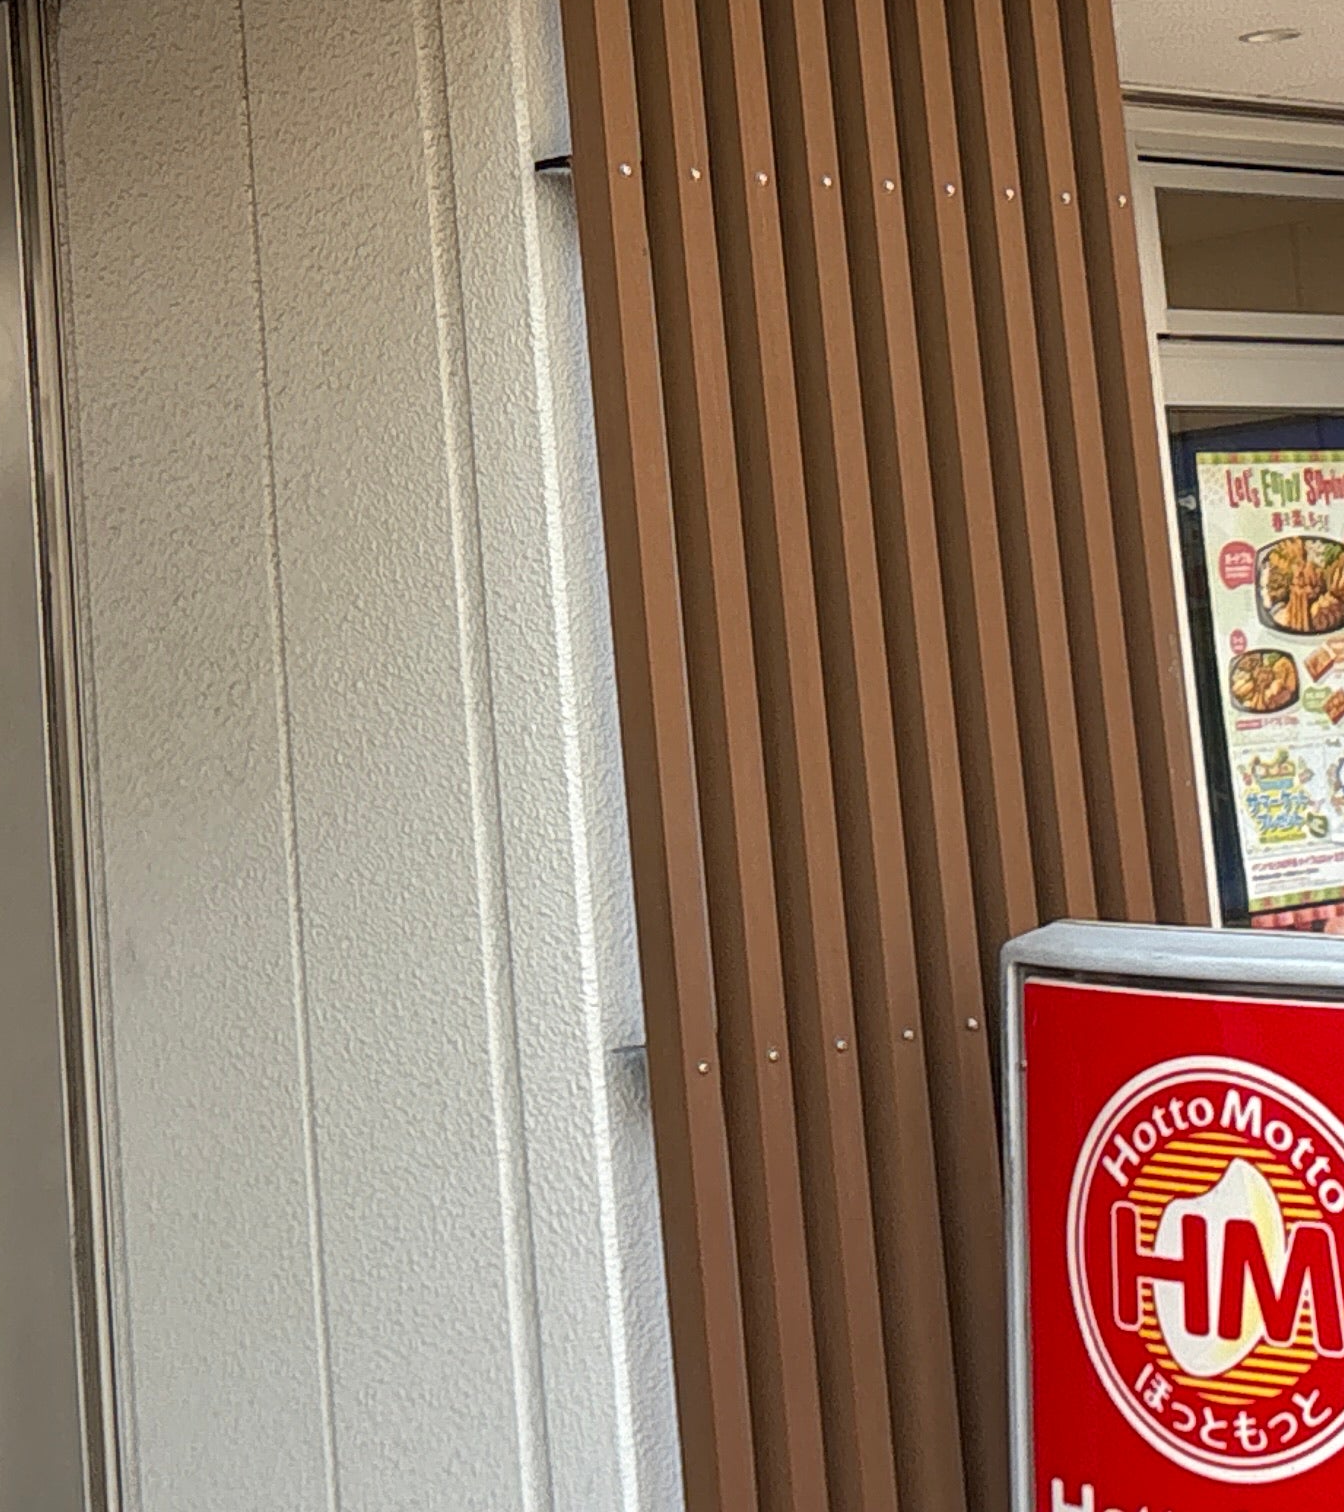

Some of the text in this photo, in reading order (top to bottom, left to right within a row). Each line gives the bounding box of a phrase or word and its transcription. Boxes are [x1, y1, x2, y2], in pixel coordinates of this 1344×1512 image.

[1134, 1361, 1333, 1454] ほっともっと
